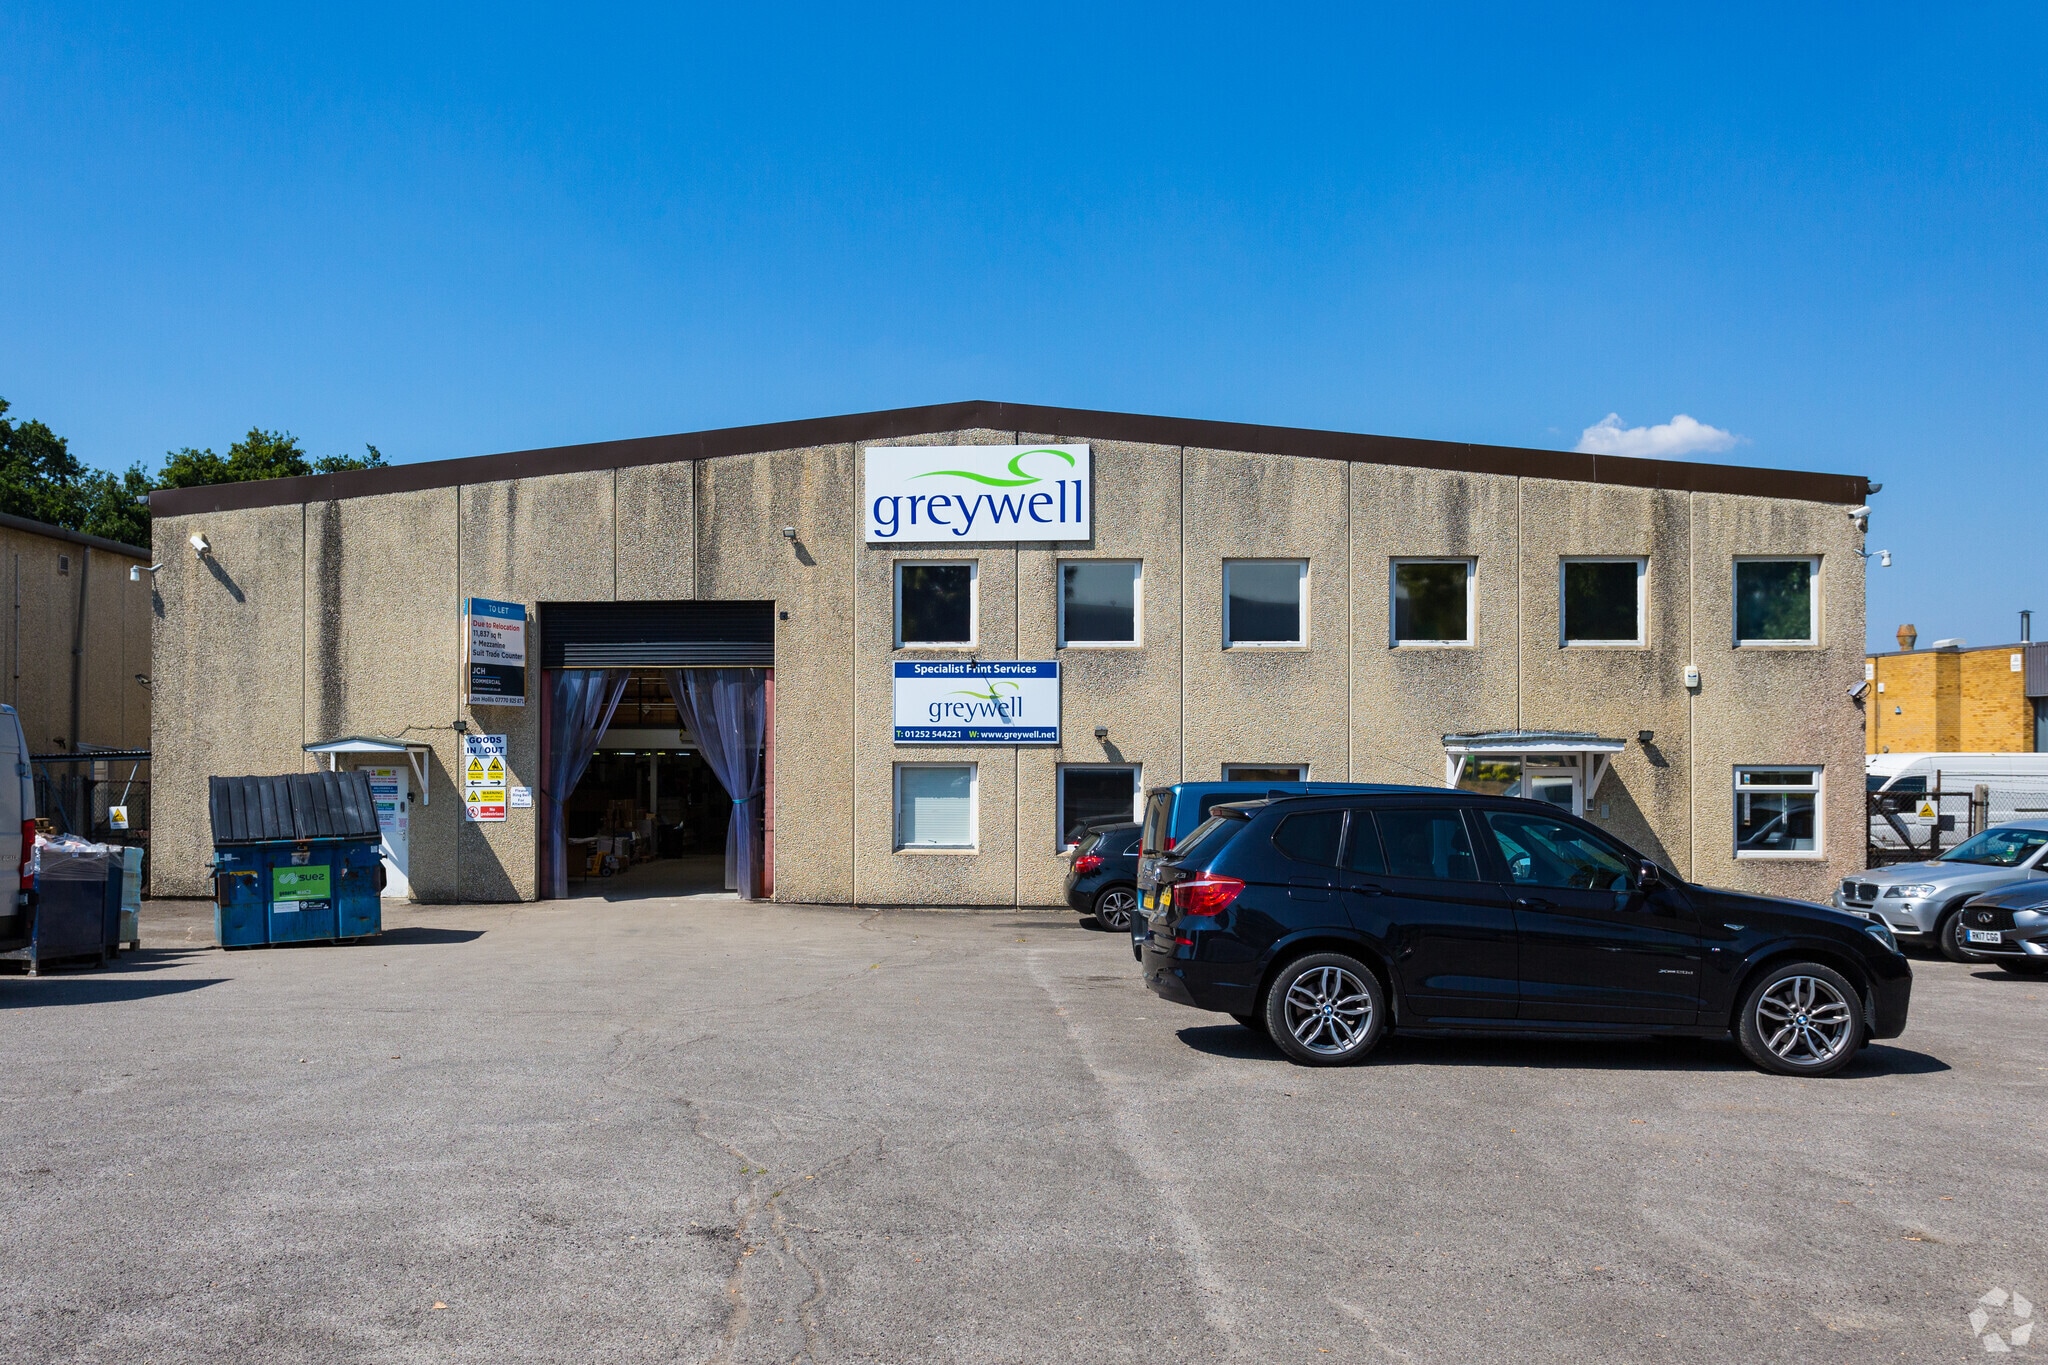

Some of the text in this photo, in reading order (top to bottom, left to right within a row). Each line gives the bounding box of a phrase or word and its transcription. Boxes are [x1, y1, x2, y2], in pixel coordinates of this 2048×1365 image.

[873, 479, 1082, 537] greywell
[488, 604, 509, 614] TO LET
[473, 619, 520, 632] Due to Relocation
[473, 630, 489, 638] 11,837
[490, 632, 497, 640] sq
[479, 640, 506, 650] Mezzanine
[473, 649, 523, 660] Suit Trade Counter
[472, 667, 486, 675] JCH
[914, 664, 964, 676] Specialist
[993, 664, 1037, 675] Services
[472, 678, 501, 686] COMMERCIAL
[929, 696, 1022, 723] greywell
[896, 730, 1055, 740] T: 01252 544221 W: www.greywell.net
[299, 874, 325, 882] suez
[1972, 932, 1998, 942] RK17 CGG
